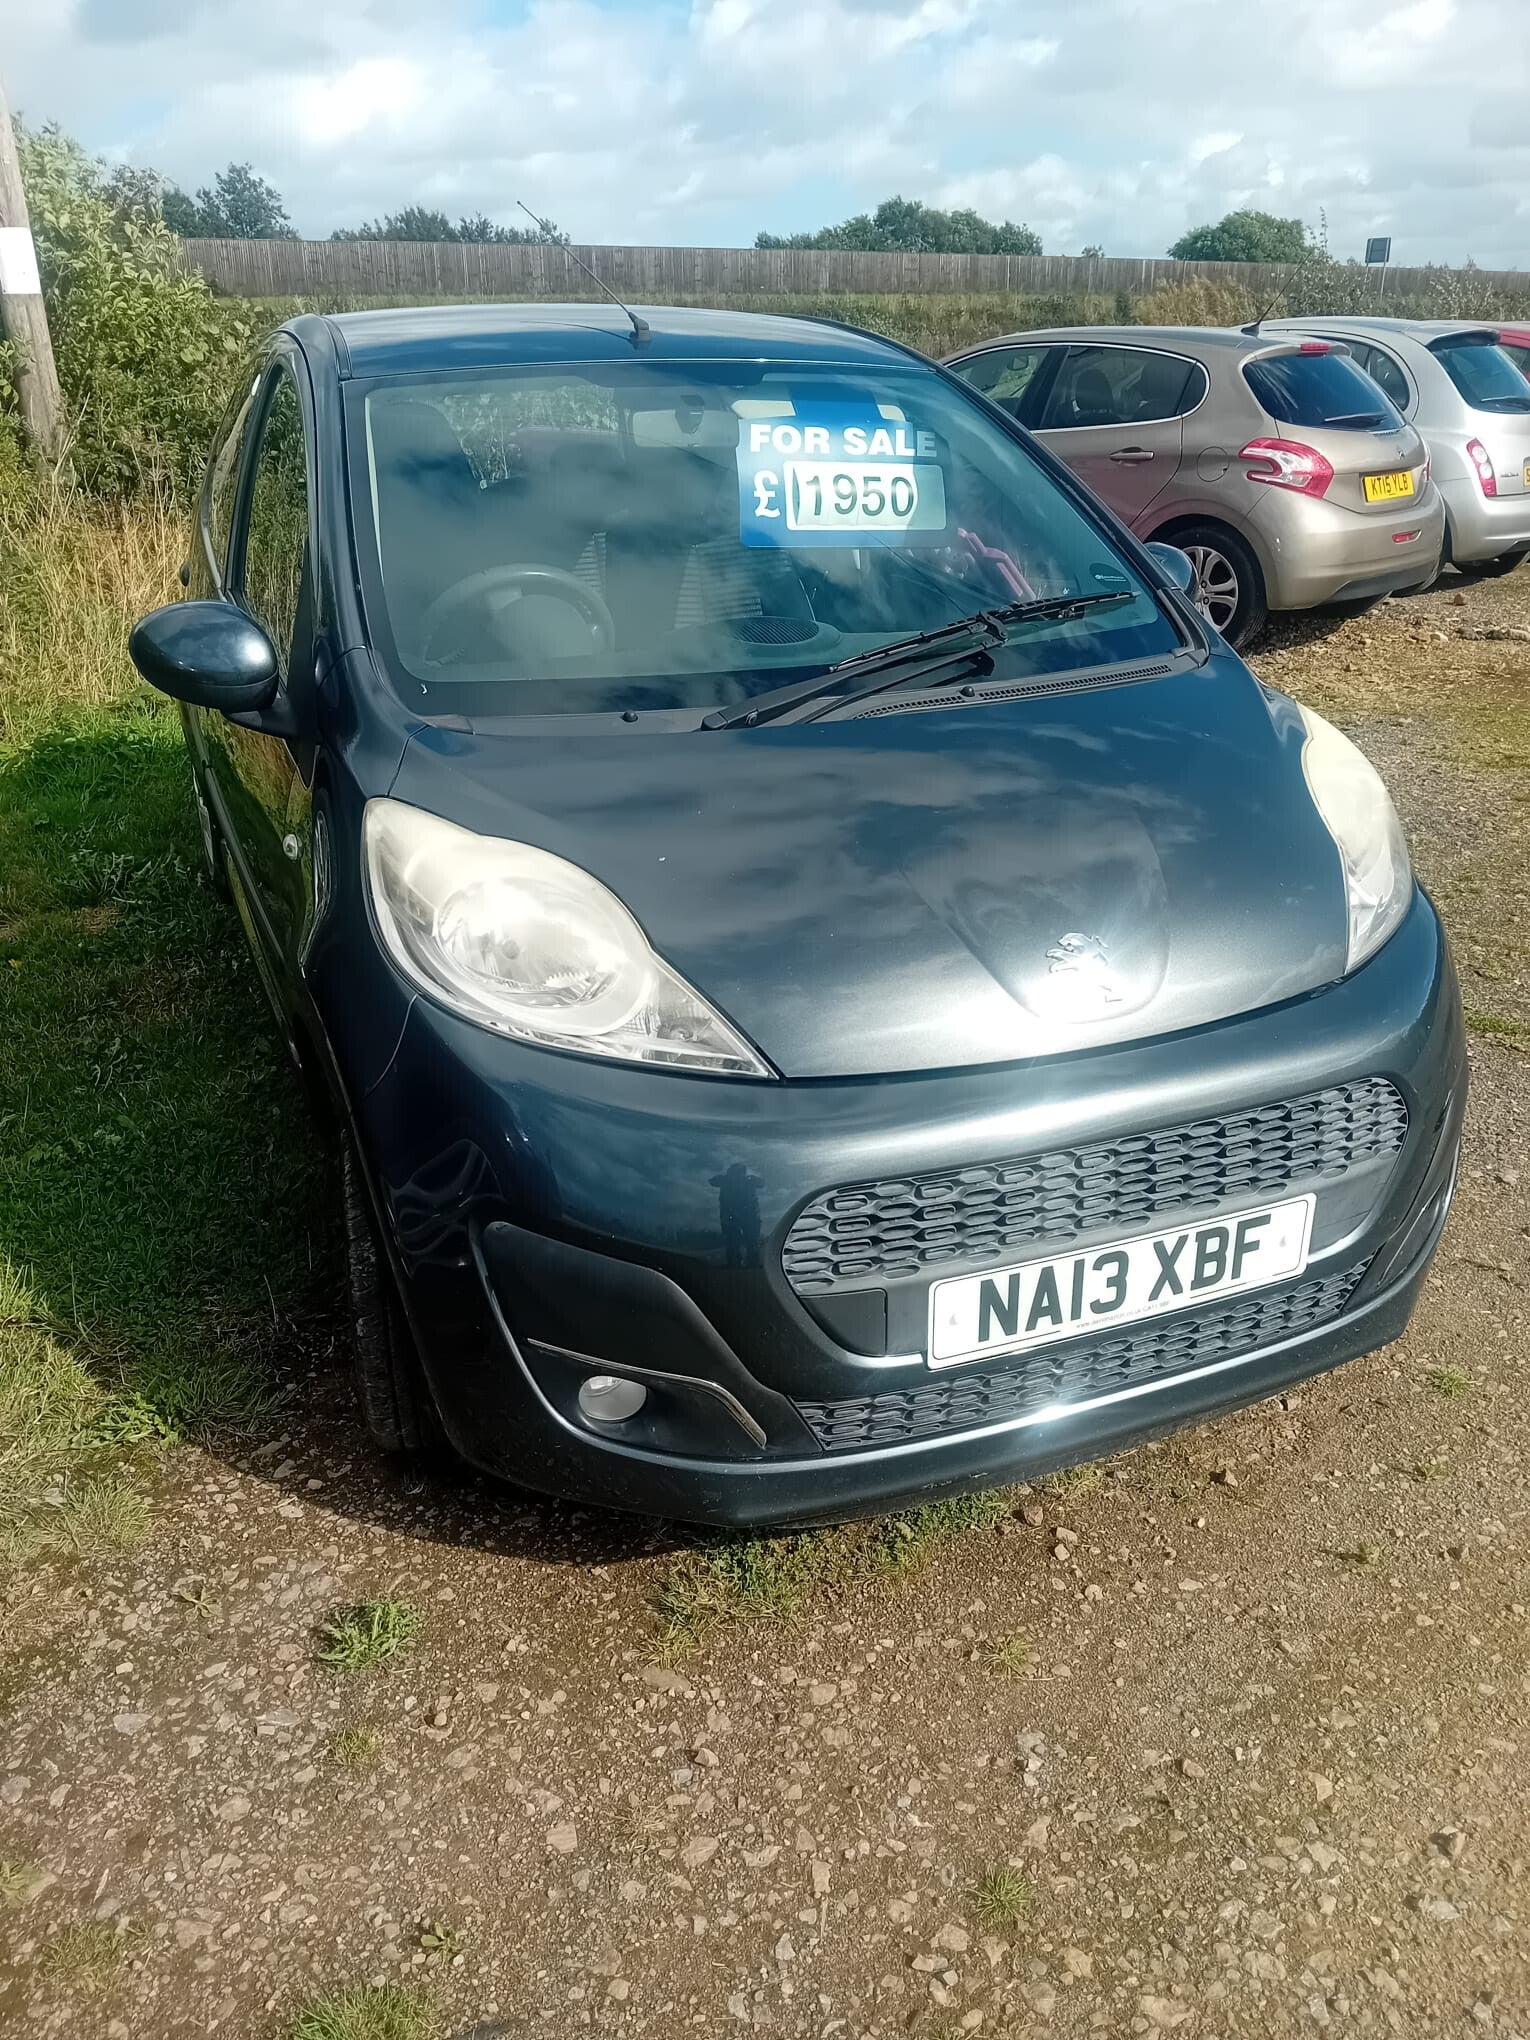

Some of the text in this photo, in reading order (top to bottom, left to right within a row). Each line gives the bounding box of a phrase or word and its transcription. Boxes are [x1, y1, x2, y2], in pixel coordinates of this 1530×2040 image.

[750, 423, 937, 457] FOR SALE
[805, 473, 914, 517] 1950
[1391, 472, 1409, 492] YLB
[978, 1213, 1271, 1343] NA13 XBF
